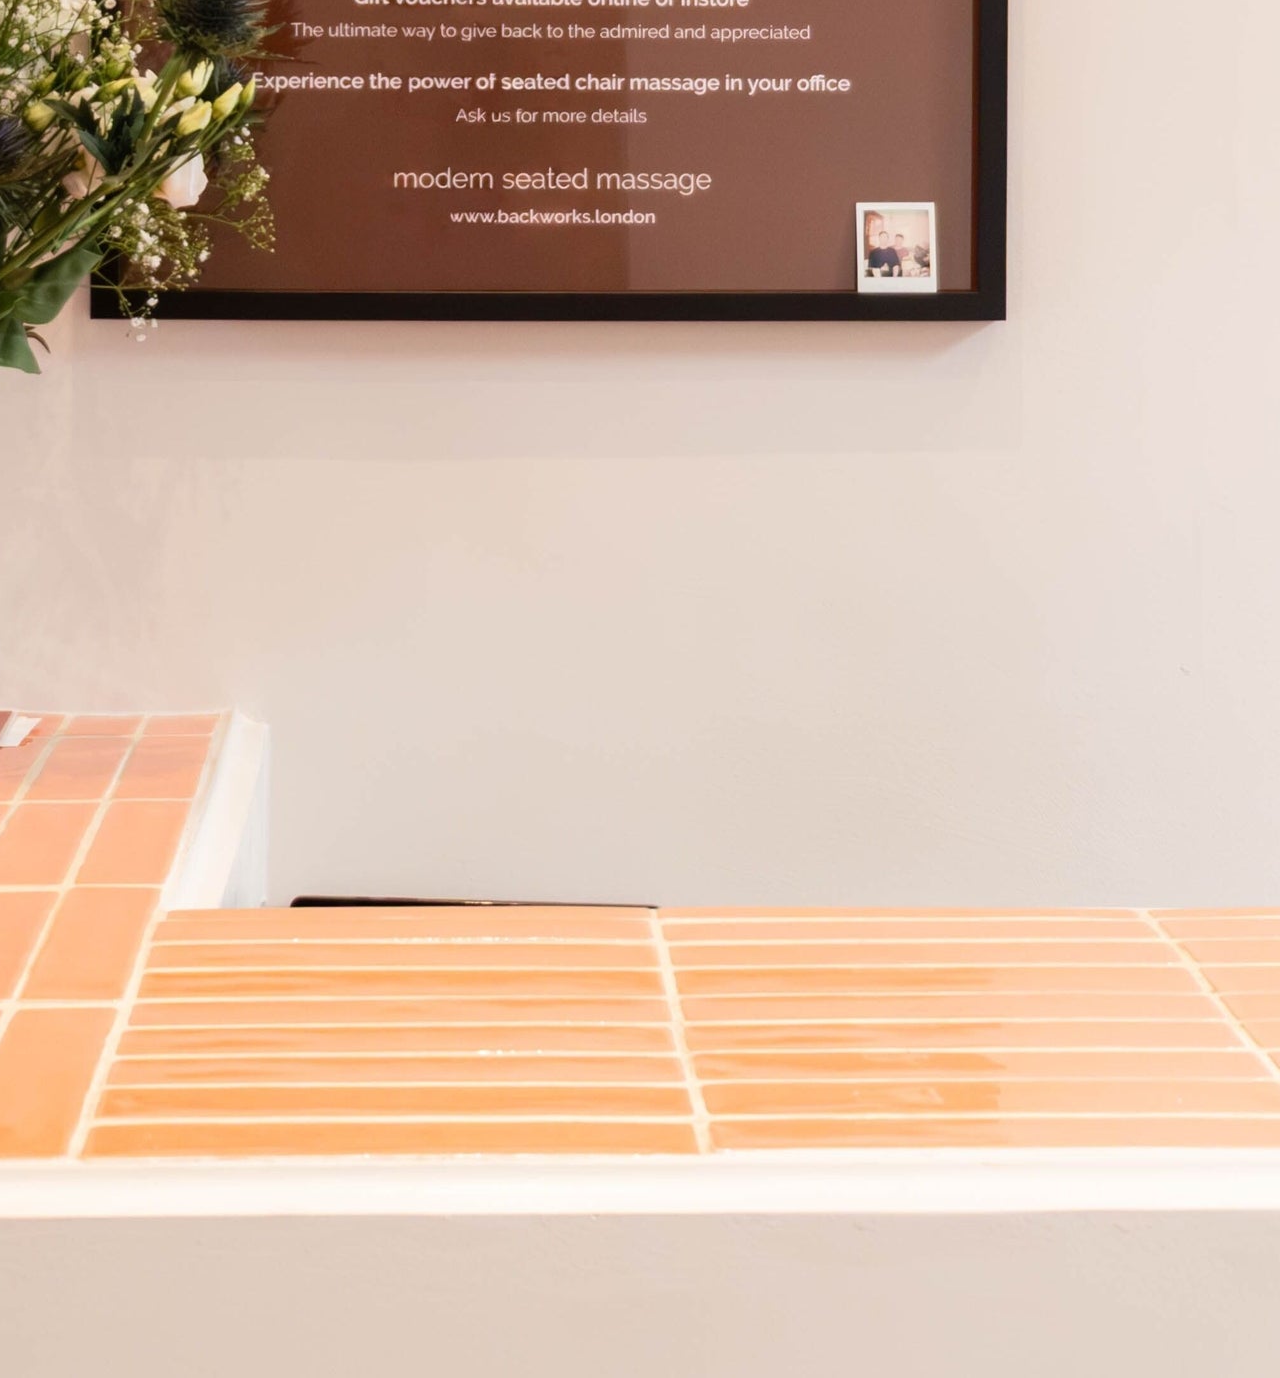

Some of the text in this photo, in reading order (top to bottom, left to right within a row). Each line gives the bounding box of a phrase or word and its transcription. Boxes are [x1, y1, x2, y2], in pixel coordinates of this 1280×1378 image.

[290, 21, 810, 43] The ultimate way to give back to the admired and appreciated
[252, 71, 851, 95] Experience the power of seated chair massage in your office
[455, 107, 647, 123] Ask us for more details
[393, 166, 712, 196] modern seated massage
[450, 208, 656, 224] www.backworks.london
